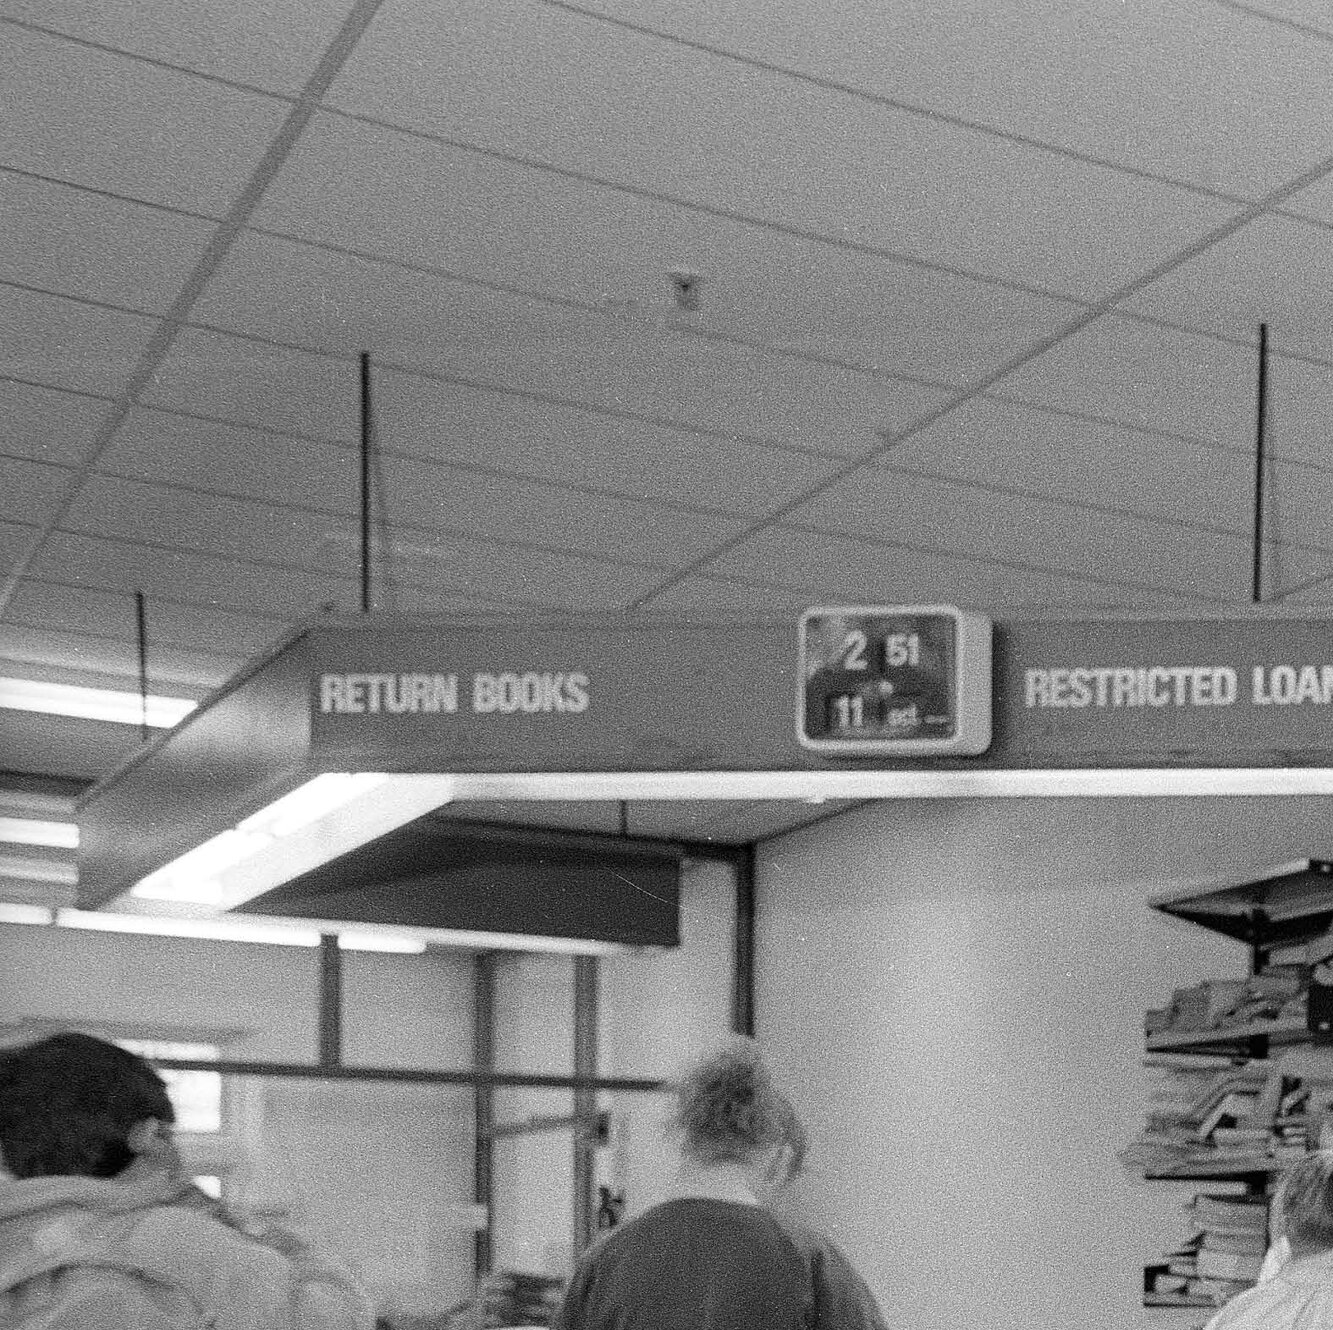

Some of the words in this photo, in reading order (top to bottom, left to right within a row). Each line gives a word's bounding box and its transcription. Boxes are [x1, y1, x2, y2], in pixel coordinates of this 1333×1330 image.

[844, 630, 868, 671] 2
[320, 673, 457, 714] RETURN
[472, 673, 590, 714] BOOKS
[1024, 666, 1237, 708] RESTRICTED
